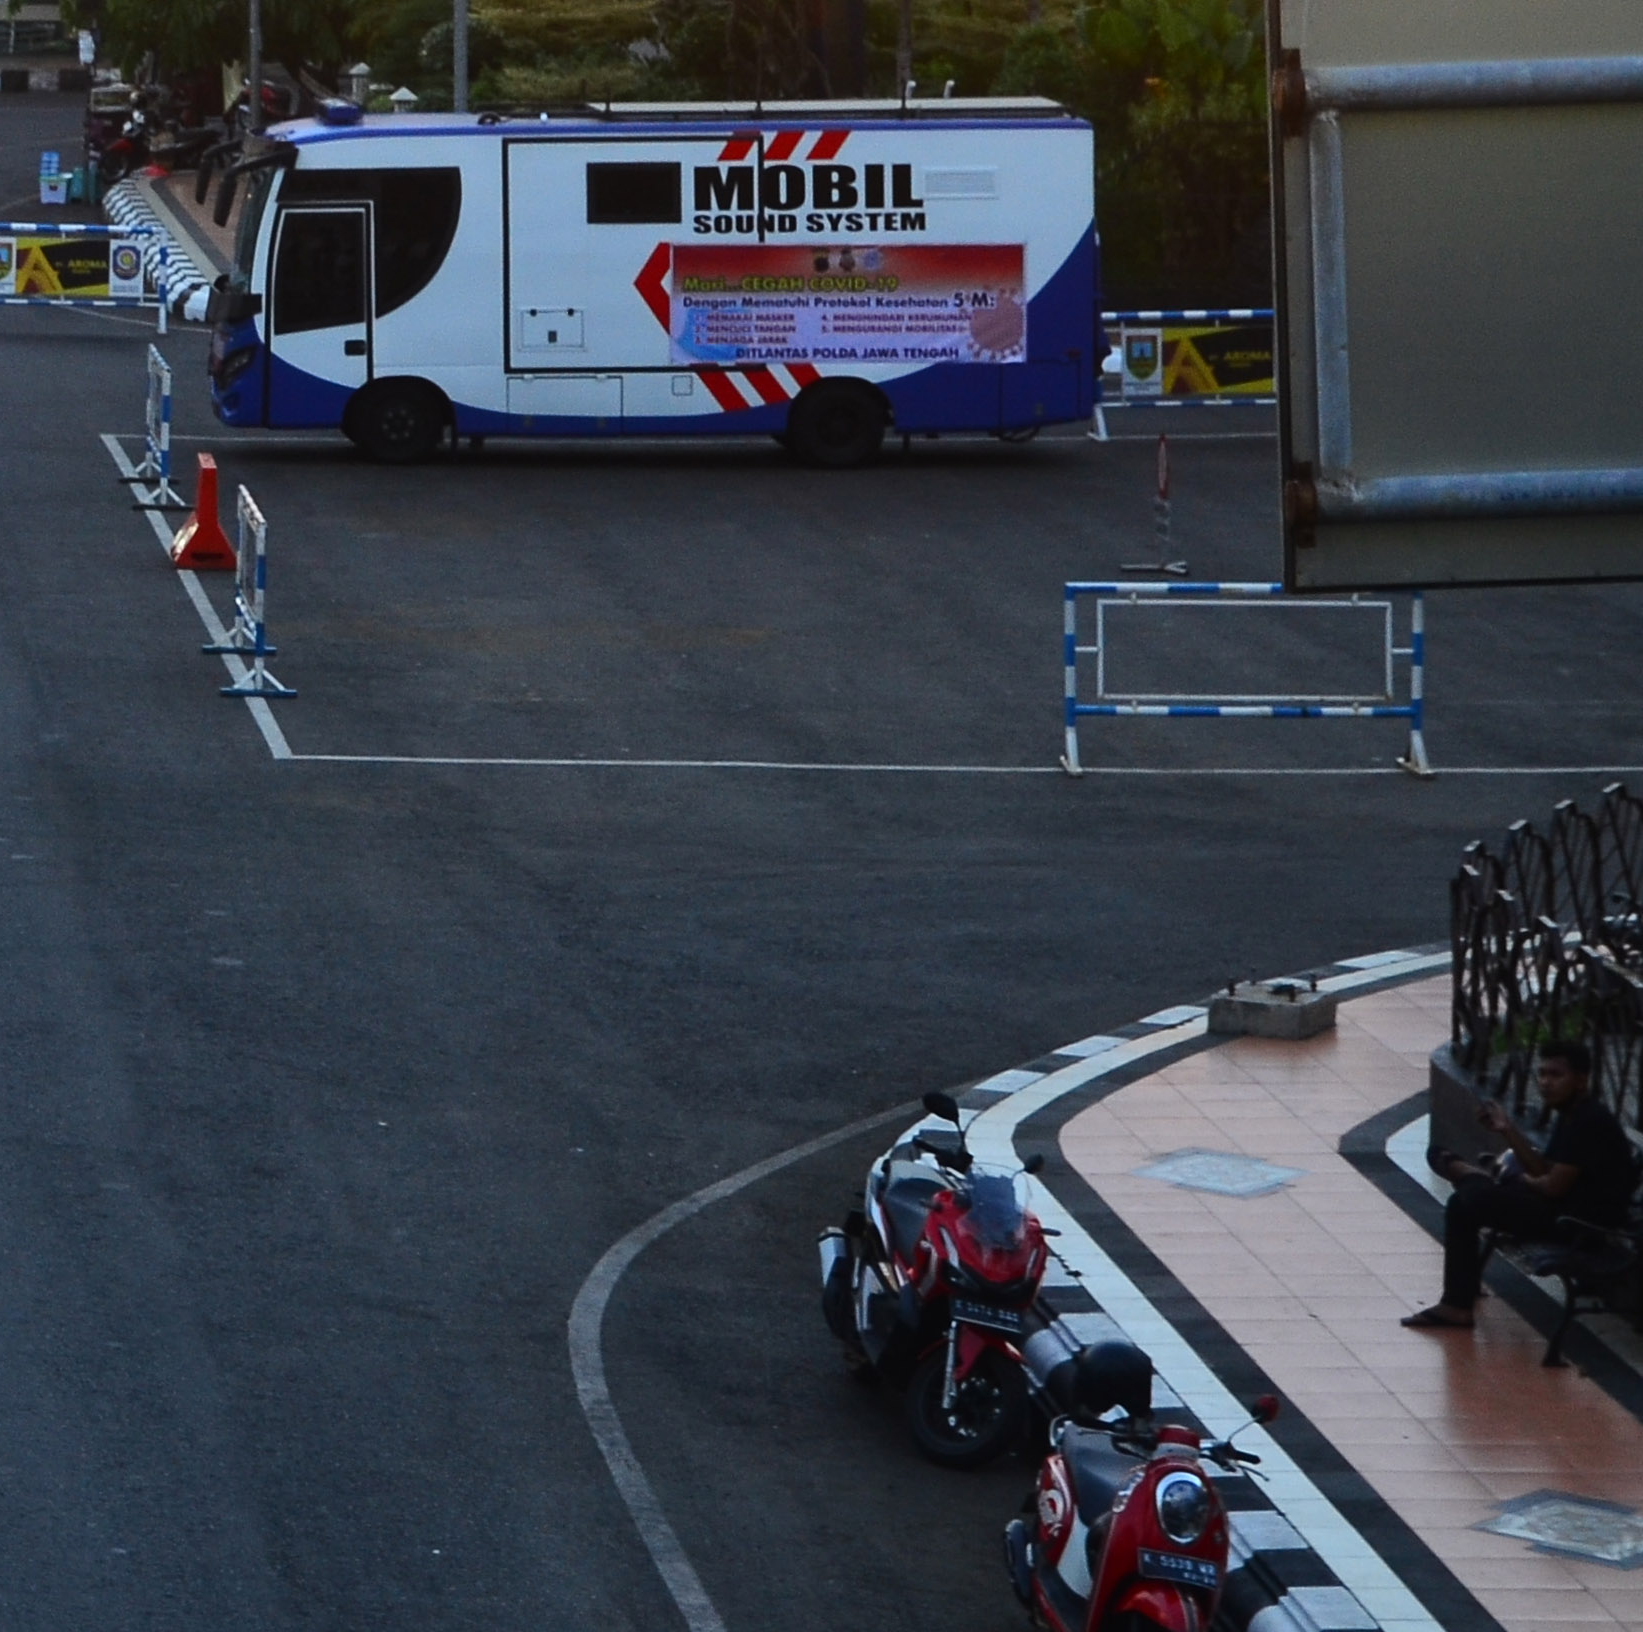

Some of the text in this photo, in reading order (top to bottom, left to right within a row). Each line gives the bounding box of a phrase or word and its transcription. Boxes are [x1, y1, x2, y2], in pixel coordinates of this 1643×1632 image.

[693, 164, 924, 211] MOBIL
[693, 212, 926, 234] SOUND SYSTEM
[809, 277, 899, 291] COVID-19
[683, 297, 737, 309] Dengan
[741, 297, 810, 308] Mematuhi
[814, 297, 871, 308] Protokol
[876, 297, 948, 308] Kesehatan
[736, 348, 960, 359] DITLANTAS POLDA JAWA TENGAH
